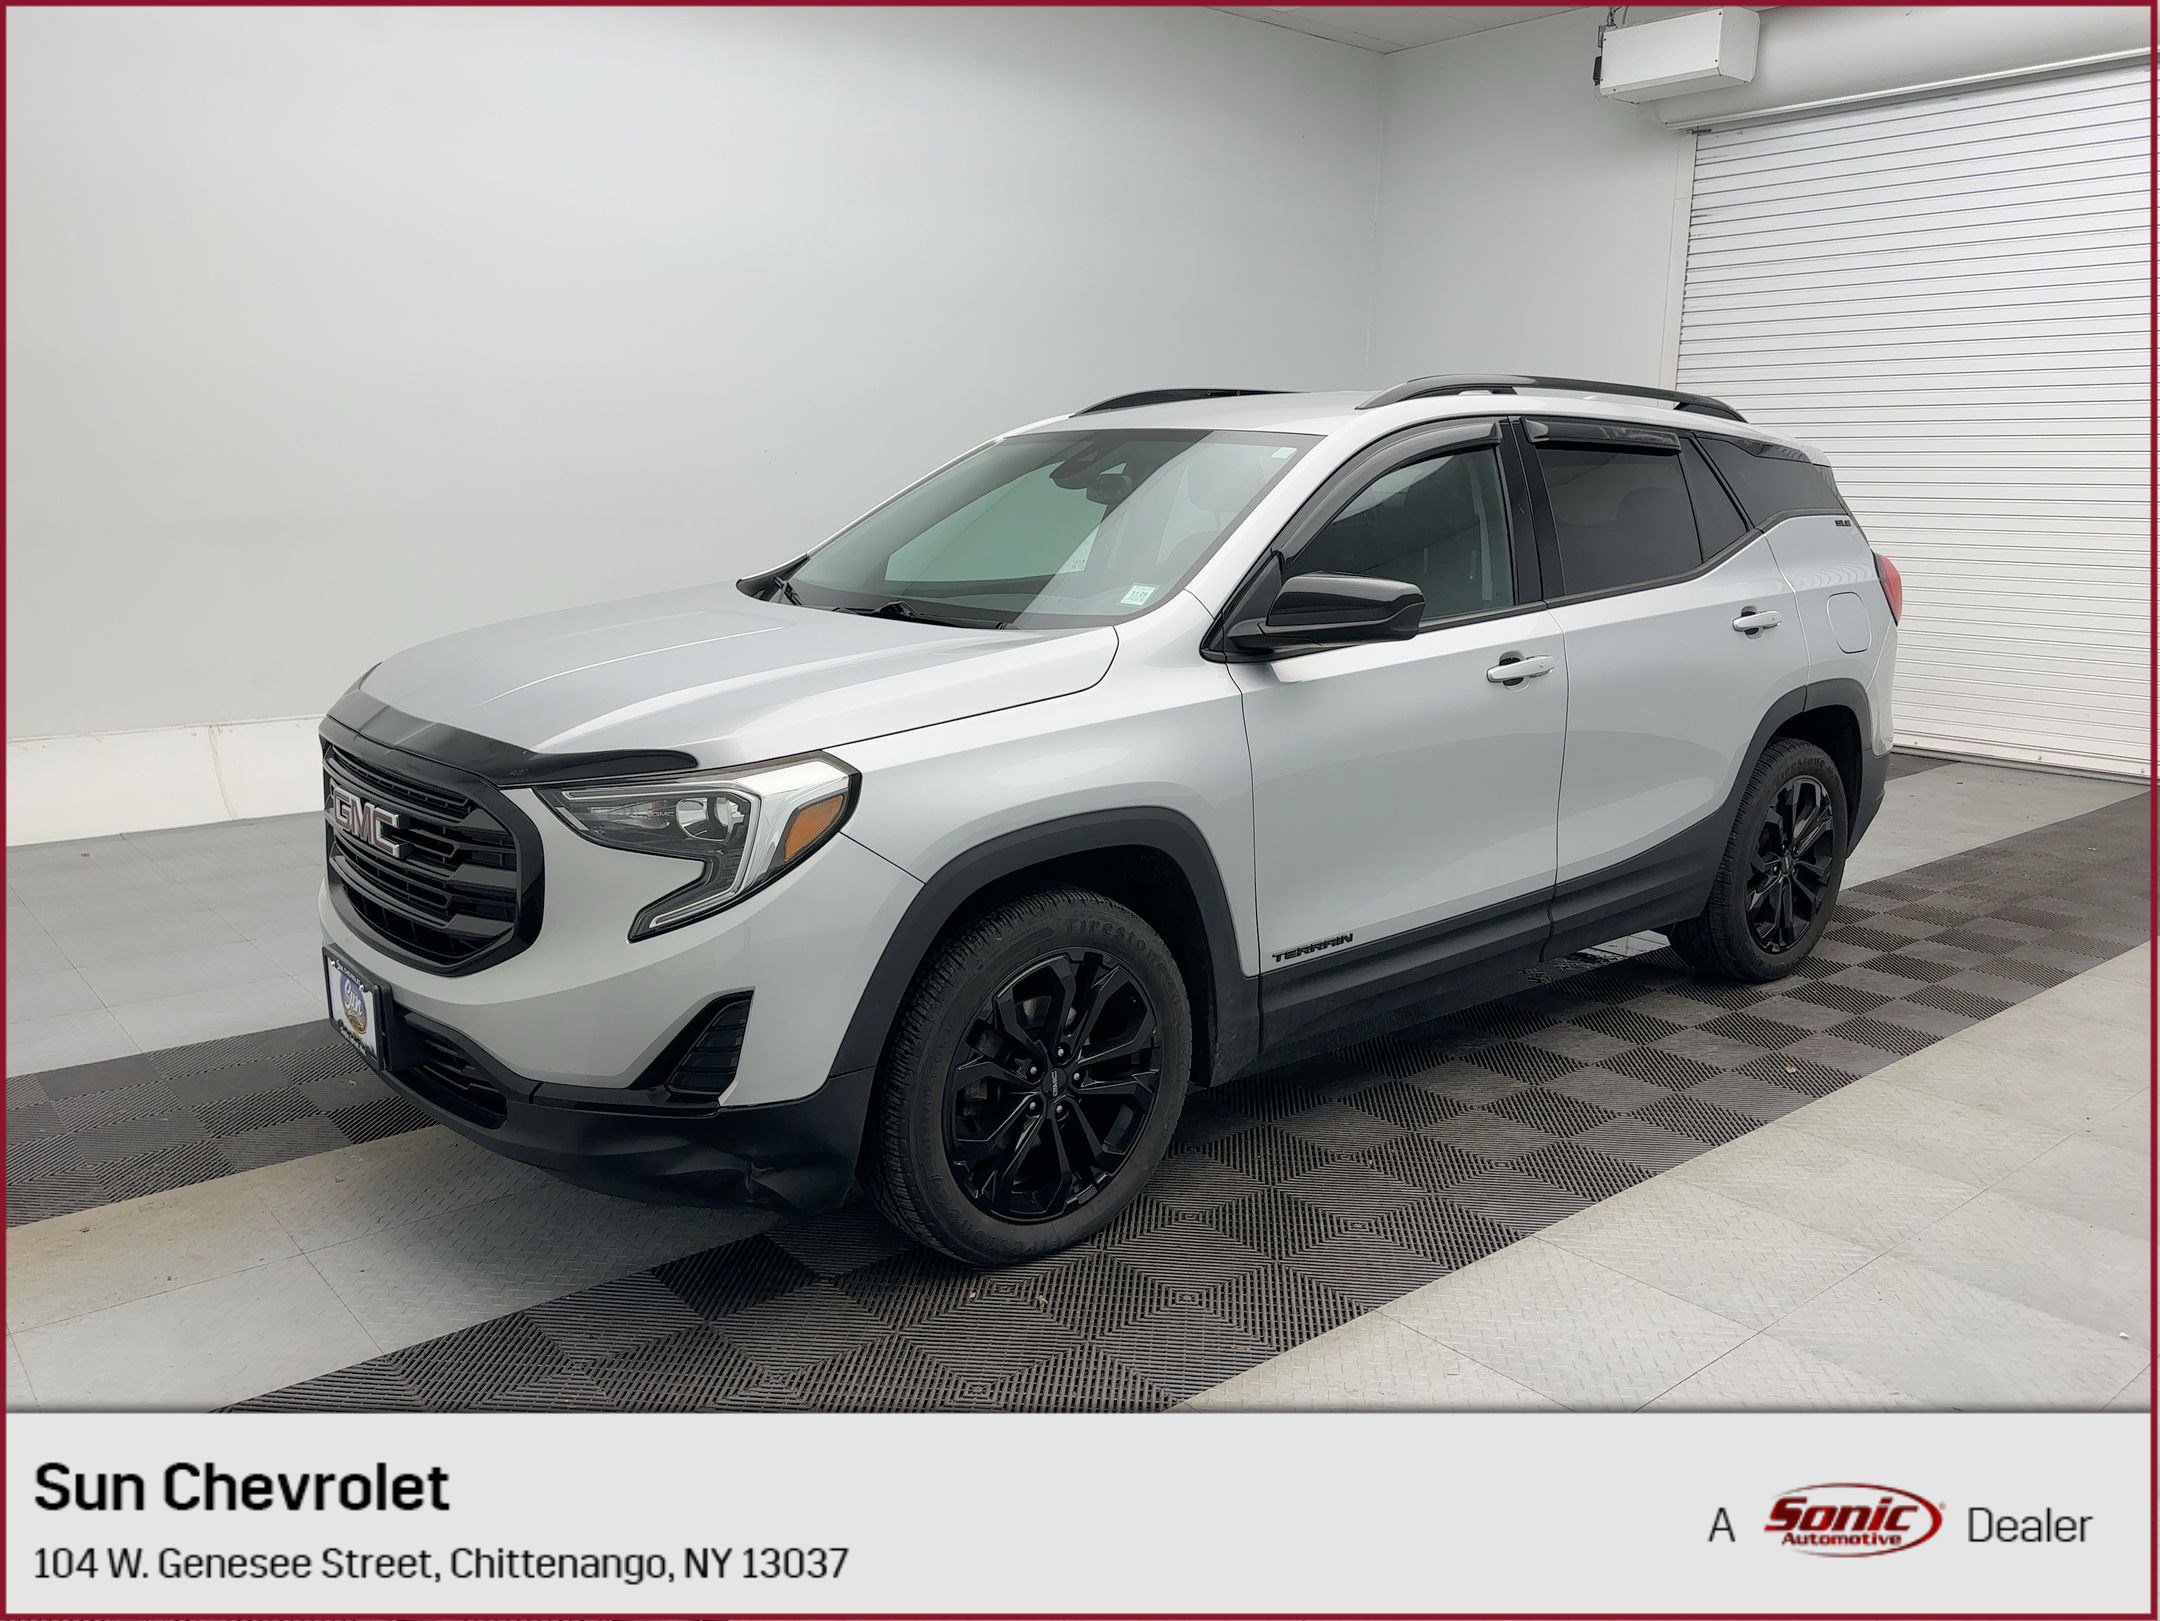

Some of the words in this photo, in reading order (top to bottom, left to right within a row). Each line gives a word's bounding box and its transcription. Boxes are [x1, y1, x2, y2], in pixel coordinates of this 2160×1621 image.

[333, 786, 400, 859] GMC
[1064, 917, 1168, 978] Firestone
[1272, 933, 1354, 963] TERRAIN
